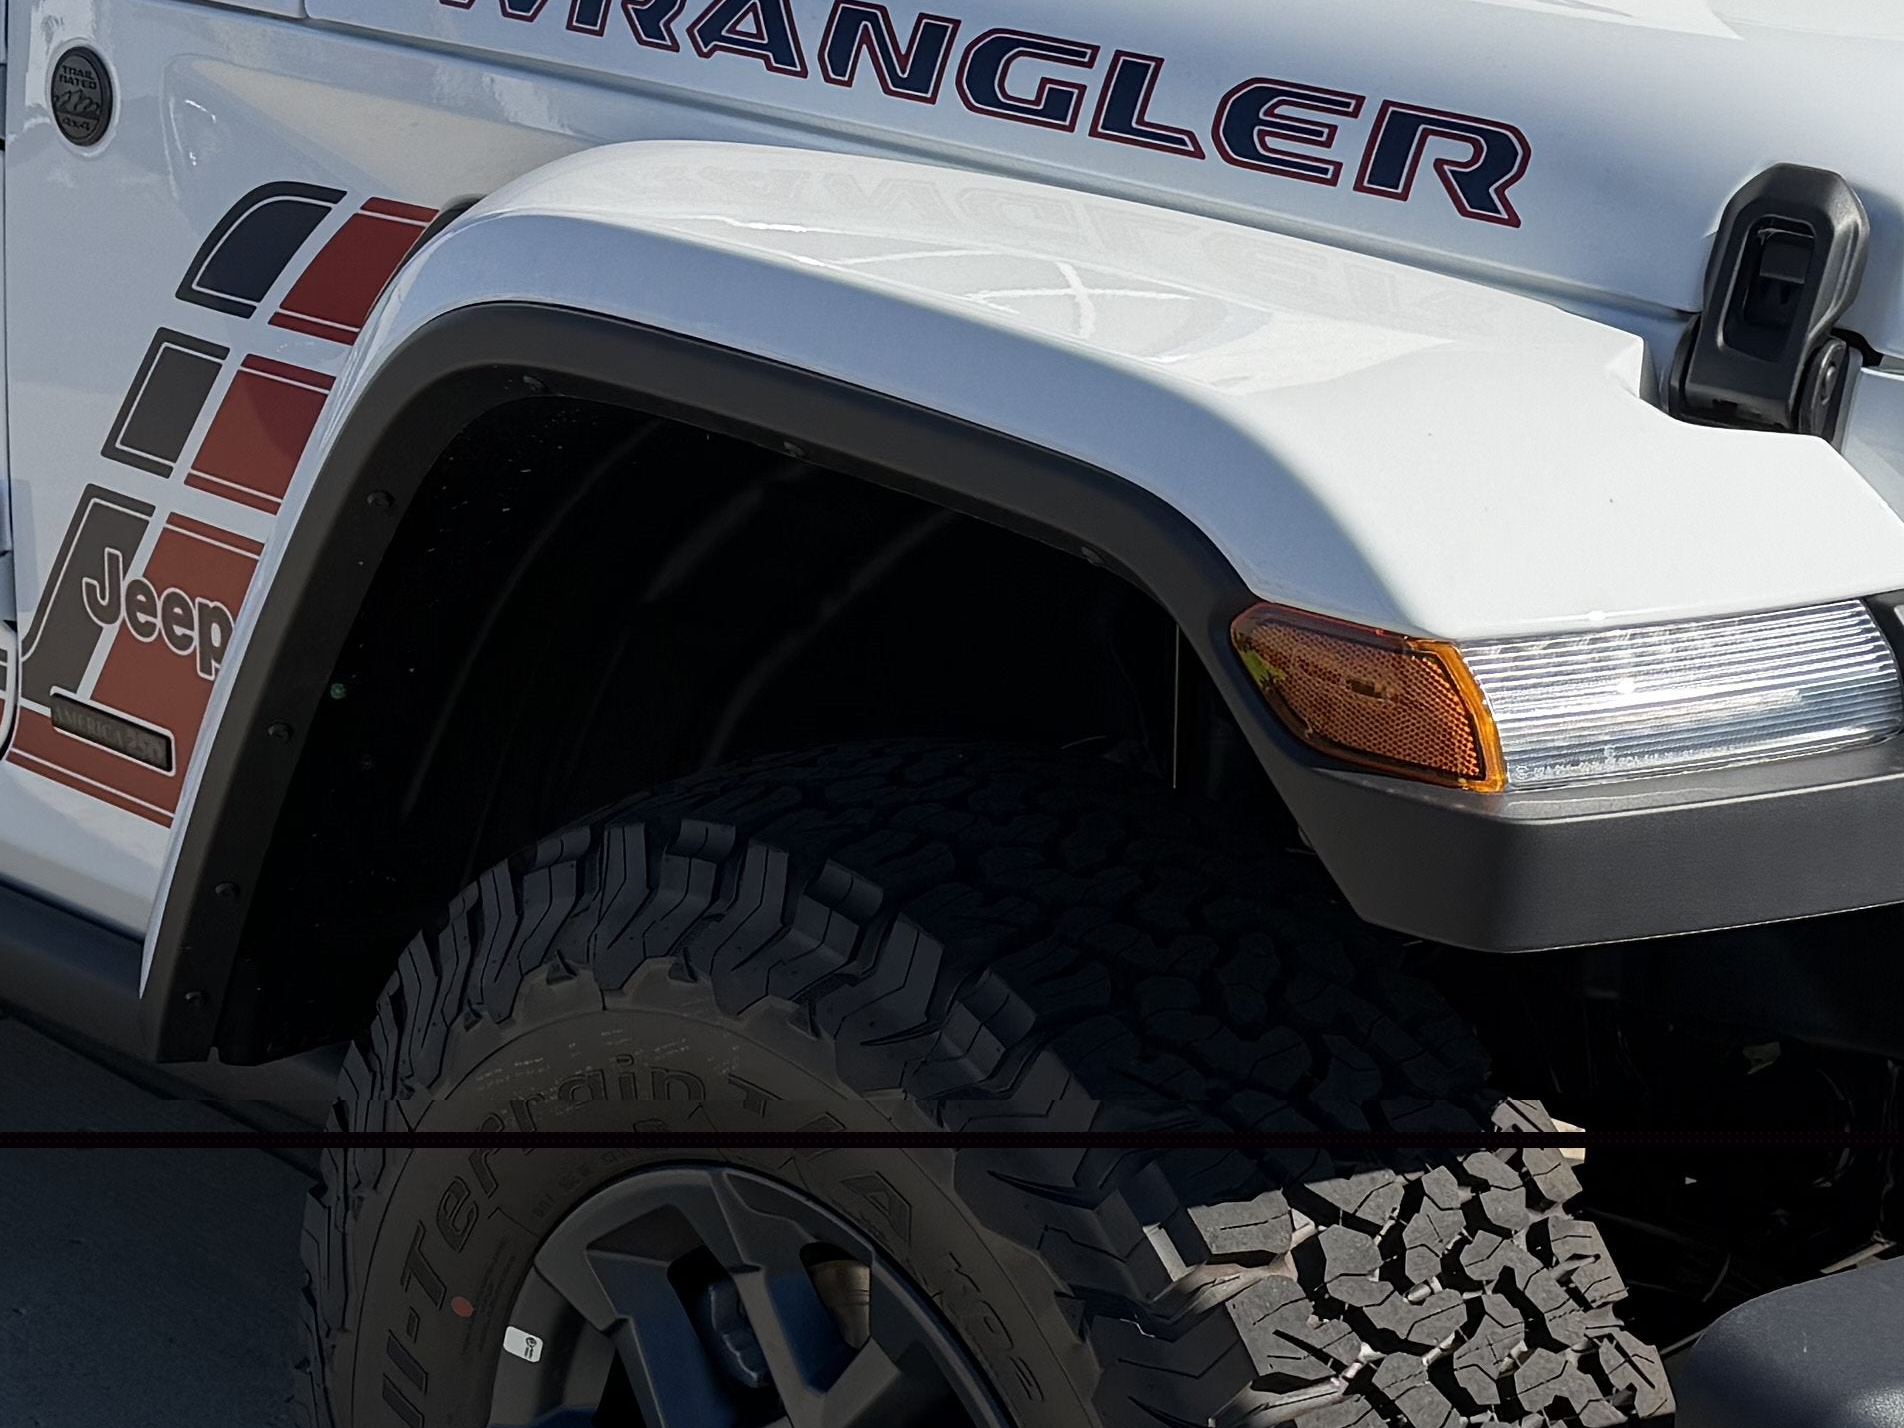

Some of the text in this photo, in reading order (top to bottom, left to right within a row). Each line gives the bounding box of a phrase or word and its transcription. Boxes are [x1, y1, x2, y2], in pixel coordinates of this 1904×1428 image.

[62, 65, 96, 81] TRAIL
[59, 74, 97, 90] RATED
[82, 547, 237, 681] Jeep
